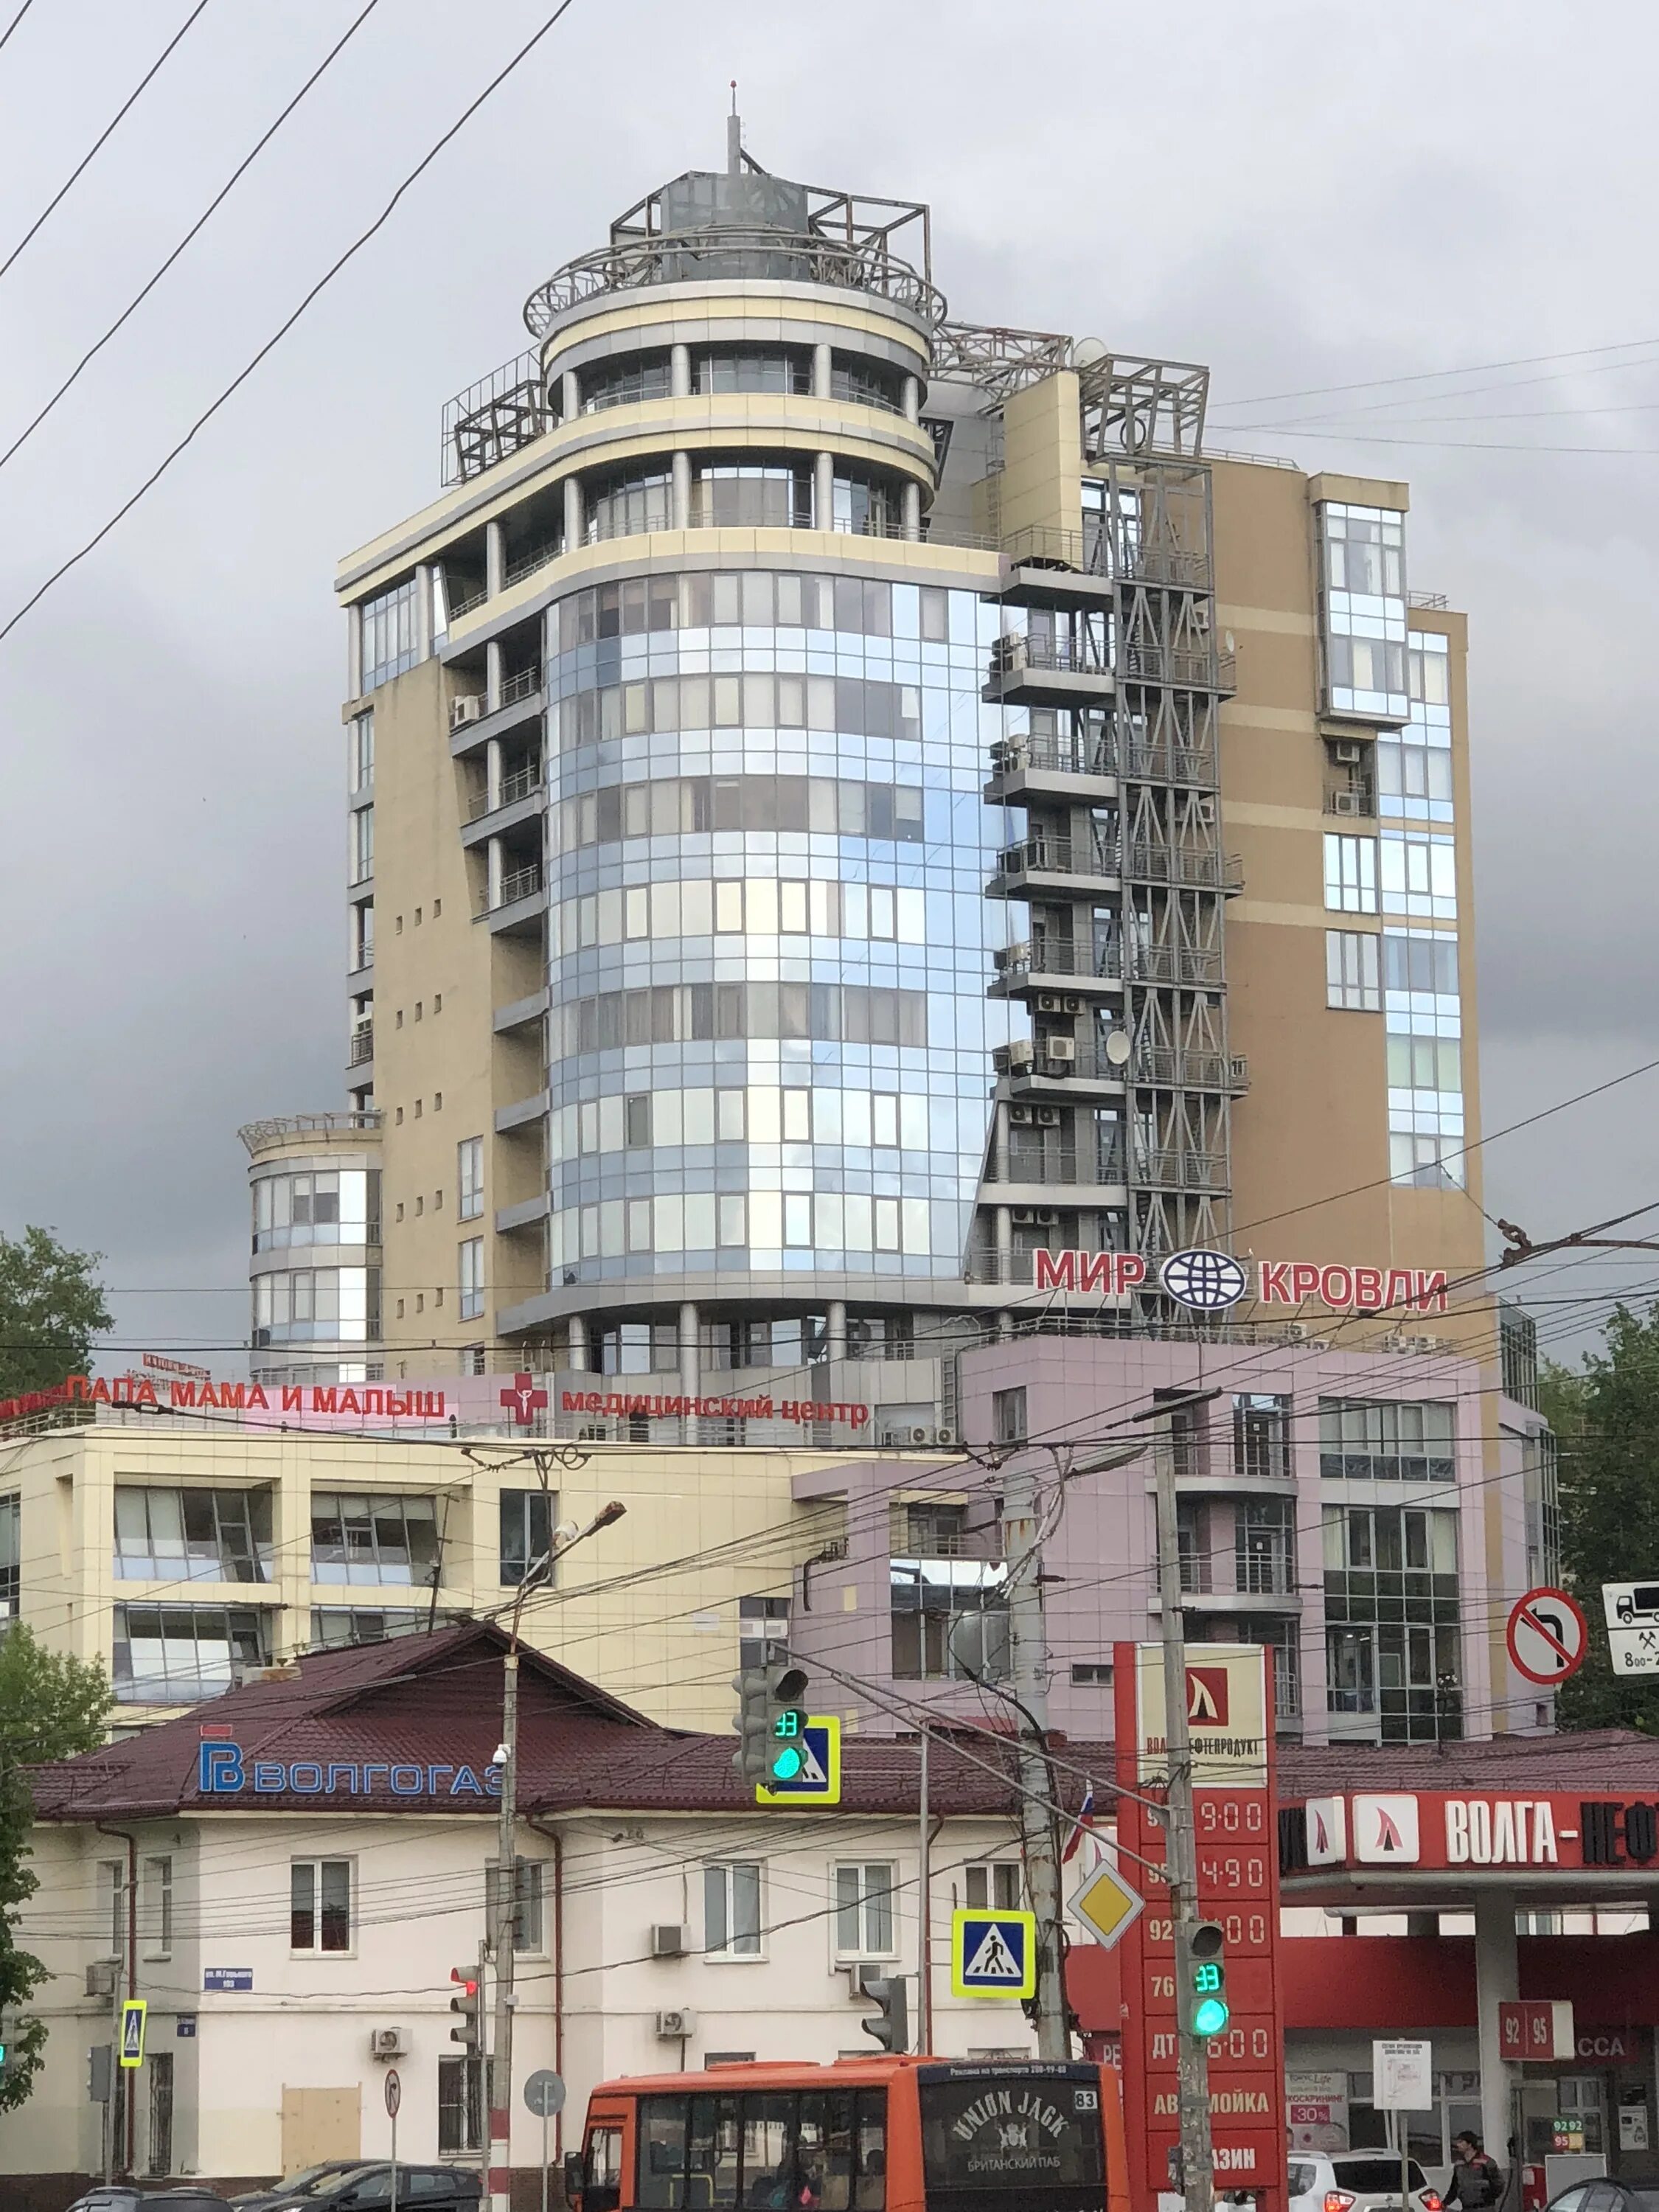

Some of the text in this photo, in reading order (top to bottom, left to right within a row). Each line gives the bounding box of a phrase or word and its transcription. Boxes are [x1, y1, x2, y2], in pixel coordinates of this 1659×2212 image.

[1034, 1248, 1448, 1312] МИР КРОВЛИ
[66, 1375, 158, 1405] ПАПА
[170, 1380, 270, 1410] МАМА
[282, 1385, 302, 1411] И
[312, 1386, 445, 1417] МАЛЫШ
[562, 1390, 869, 1430] медицинский центр
[254, 1762, 504, 1795] ВОЛГОГАЗ
[1150, 1919, 1173, 1941] 92
[1151, 1976, 1174, 1997] 76
[1506, 2017, 1520, 2044] 92
[1533, 2017, 1547, 2044] 95
[1152, 2034, 1176, 2059] ДТ
[1075, 2093, 1095, 2108] 83
[952, 2090, 1070, 2141] UNION JACK
[1554, 2120, 1582, 2131] 92 92
[1554, 2136, 1568, 2146] 95
[967, 2157, 1061, 2172] БРИТАНСКИЙ ПАБ
